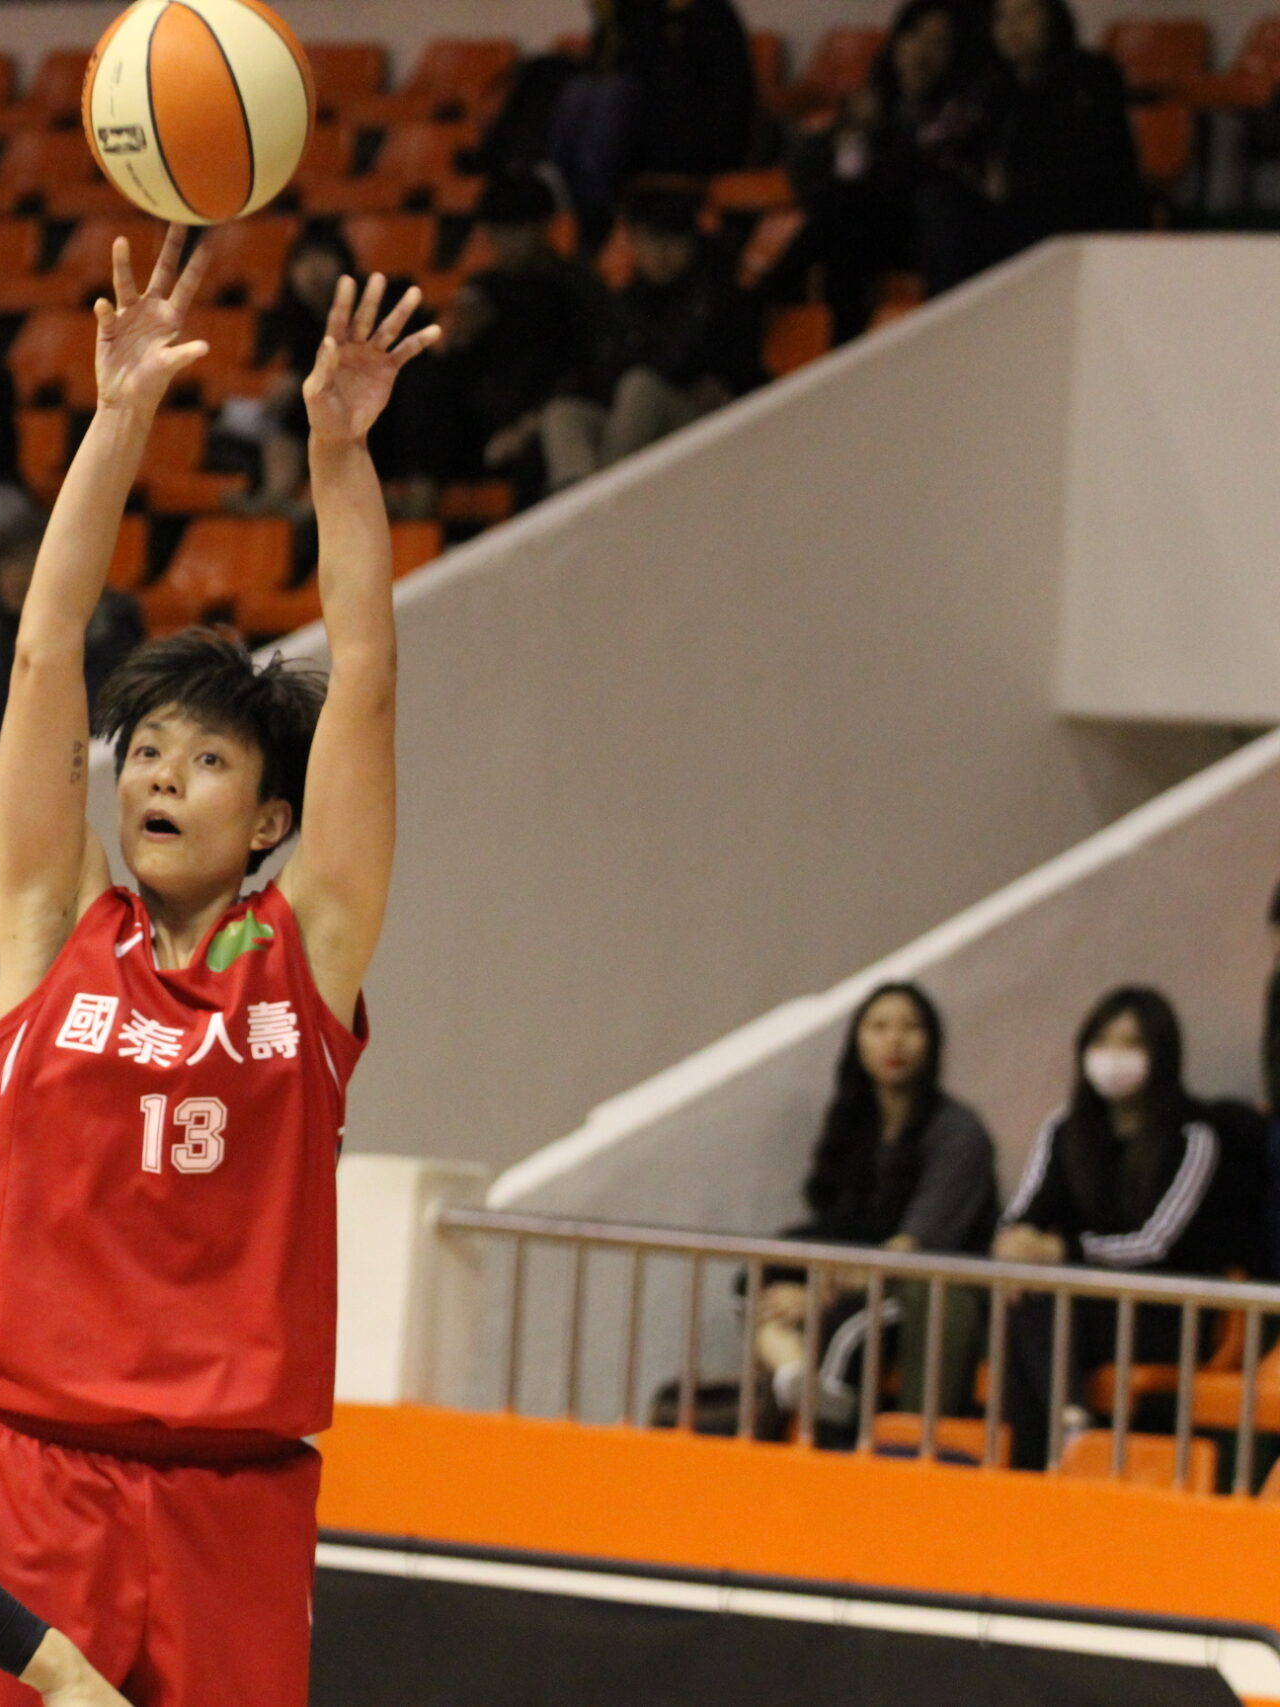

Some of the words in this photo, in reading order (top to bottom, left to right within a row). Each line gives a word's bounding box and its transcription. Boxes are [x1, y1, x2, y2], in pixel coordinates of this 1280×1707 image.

[55, 993, 301, 1067] 國泰人壽
[140, 1093, 227, 1174] 13
